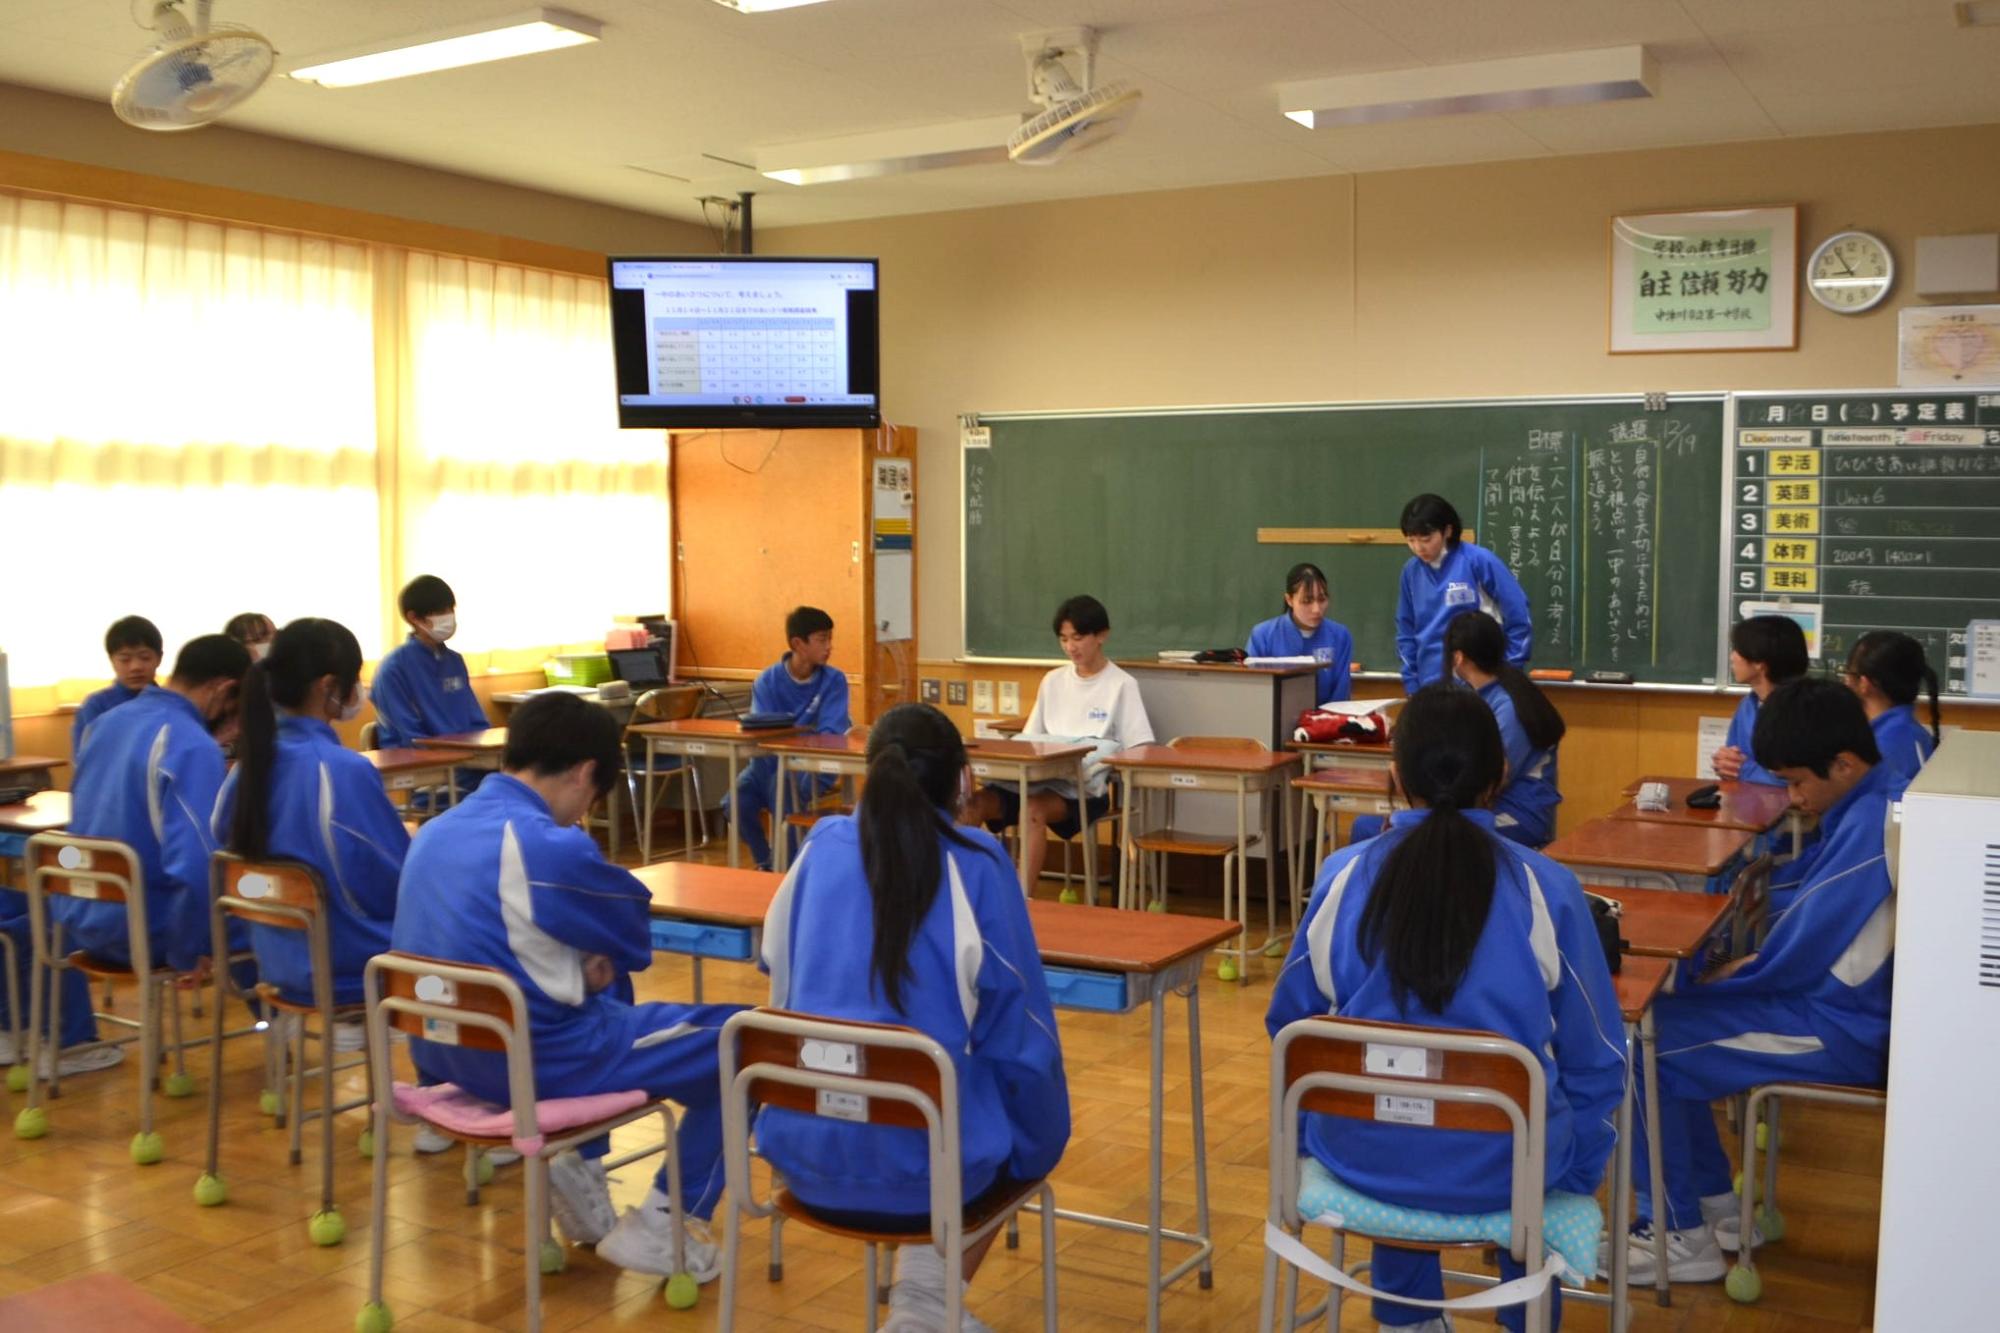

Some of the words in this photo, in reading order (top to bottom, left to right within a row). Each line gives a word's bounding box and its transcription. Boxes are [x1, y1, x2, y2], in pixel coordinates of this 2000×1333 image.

[1640, 270, 1672, 297] 自主
[1680, 270, 1720, 296] 信頼
[1725, 267, 1769, 295] 努力
[1608, 419, 1648, 443] 議題
[1744, 433, 1805, 445] December
[1923, 431, 1964, 443] Friday
[1528, 430, 1564, 451] 目標
[1746, 456, 1755, 472] 1
[1776, 455, 1812, 471] 学活
[1742, 485, 1758, 501] 2
[1776, 484, 1811, 501] 英語
[1741, 514, 1757, 530] 3
[1775, 513, 1810, 529] 美術
[1740, 543, 1756, 558] 4
[1773, 541, 1808, 559] 体育
[1739, 572, 1756, 588] 5
[1773, 572, 1808, 588] 理科
